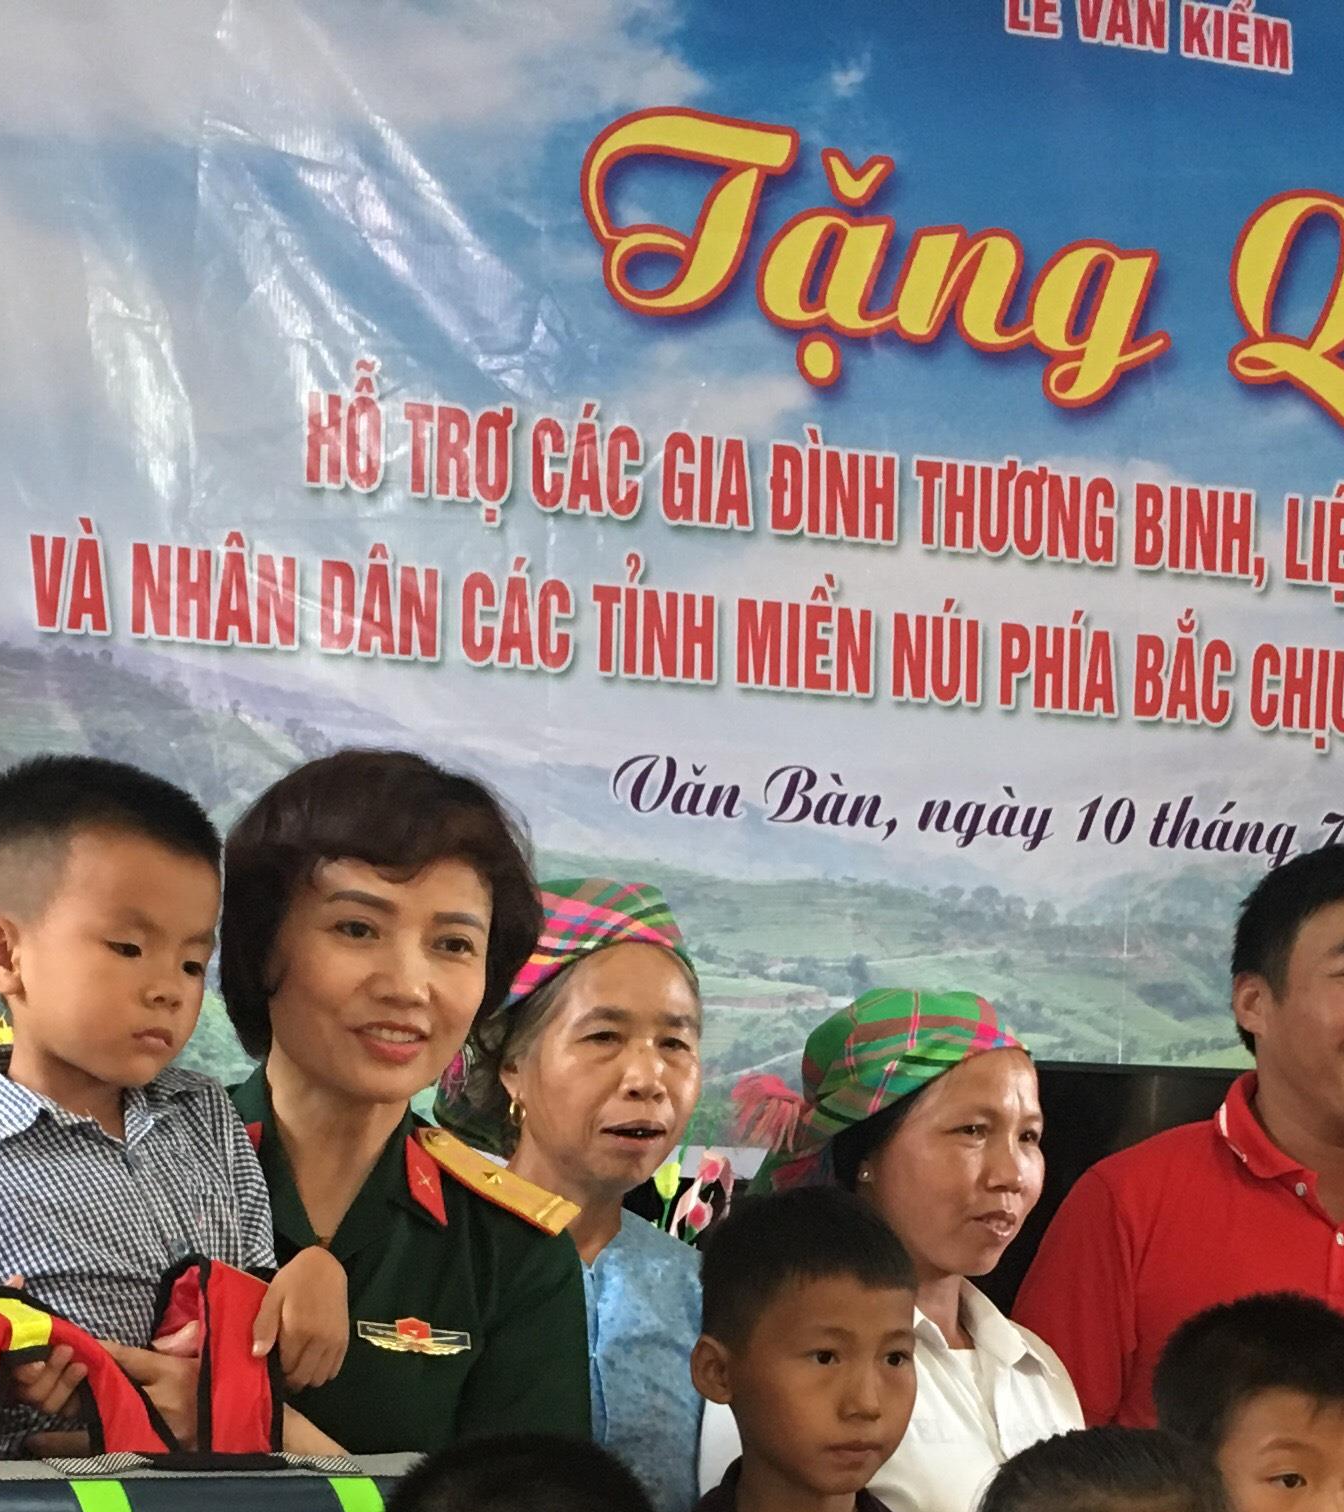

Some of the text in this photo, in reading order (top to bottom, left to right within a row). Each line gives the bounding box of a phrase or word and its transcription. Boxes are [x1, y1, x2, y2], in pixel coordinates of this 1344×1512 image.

[580, 106, 1169, 406] Tặng
[307, 360, 379, 485] HỖ
[406, 403, 513, 522] TRỢ
[533, 405, 639, 515] CÁC
[663, 433, 749, 525] GIA
[771, 429, 894, 540] ĐÌNH
[917, 461, 1114, 562] THƯƠNG
[1135, 484, 1264, 586] BINH,
[32, 519, 106, 630] VÀ
[133, 533, 294, 643] NHÂN
[322, 546, 437, 656] DÂN
[463, 559, 570, 667] CÁC
[593, 555, 714, 680] TỈNH
[737, 575, 871, 693] MIỀN
[893, 599, 978, 702] NÚI
[1001, 611, 1114, 713] PHÍA
[1135, 609, 1231, 723] BẮC
[614, 756, 739, 817] Văn
[765, 767, 896, 838] Bàn,
[919, 787, 1052, 850] ngày
[1078, 797, 1135, 843] 10
[1150, 797, 1297, 872] tháng
